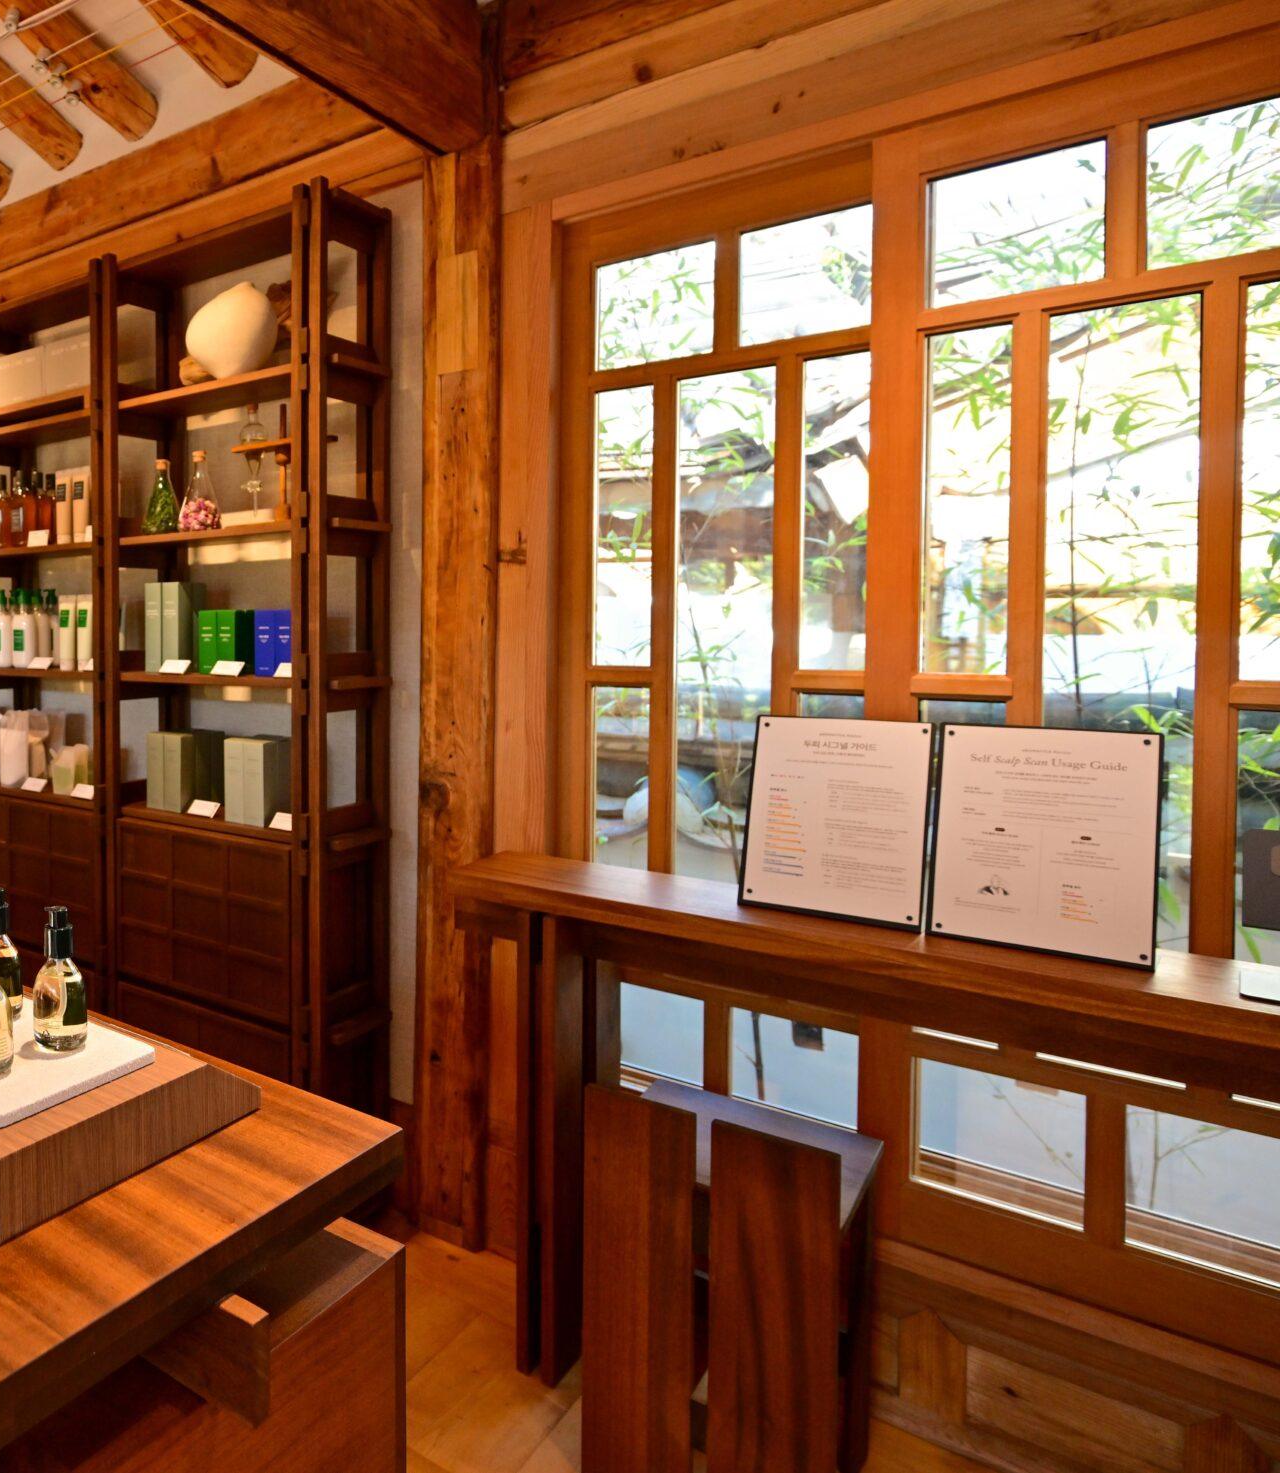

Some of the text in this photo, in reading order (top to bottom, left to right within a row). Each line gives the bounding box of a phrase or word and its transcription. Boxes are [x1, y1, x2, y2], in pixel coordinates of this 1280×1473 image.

[822, 740, 849, 751] 시그널
[850, 742, 881, 752] 가이드
[970, 753, 1128, 772] Self Scalp Scan Usage Guide
